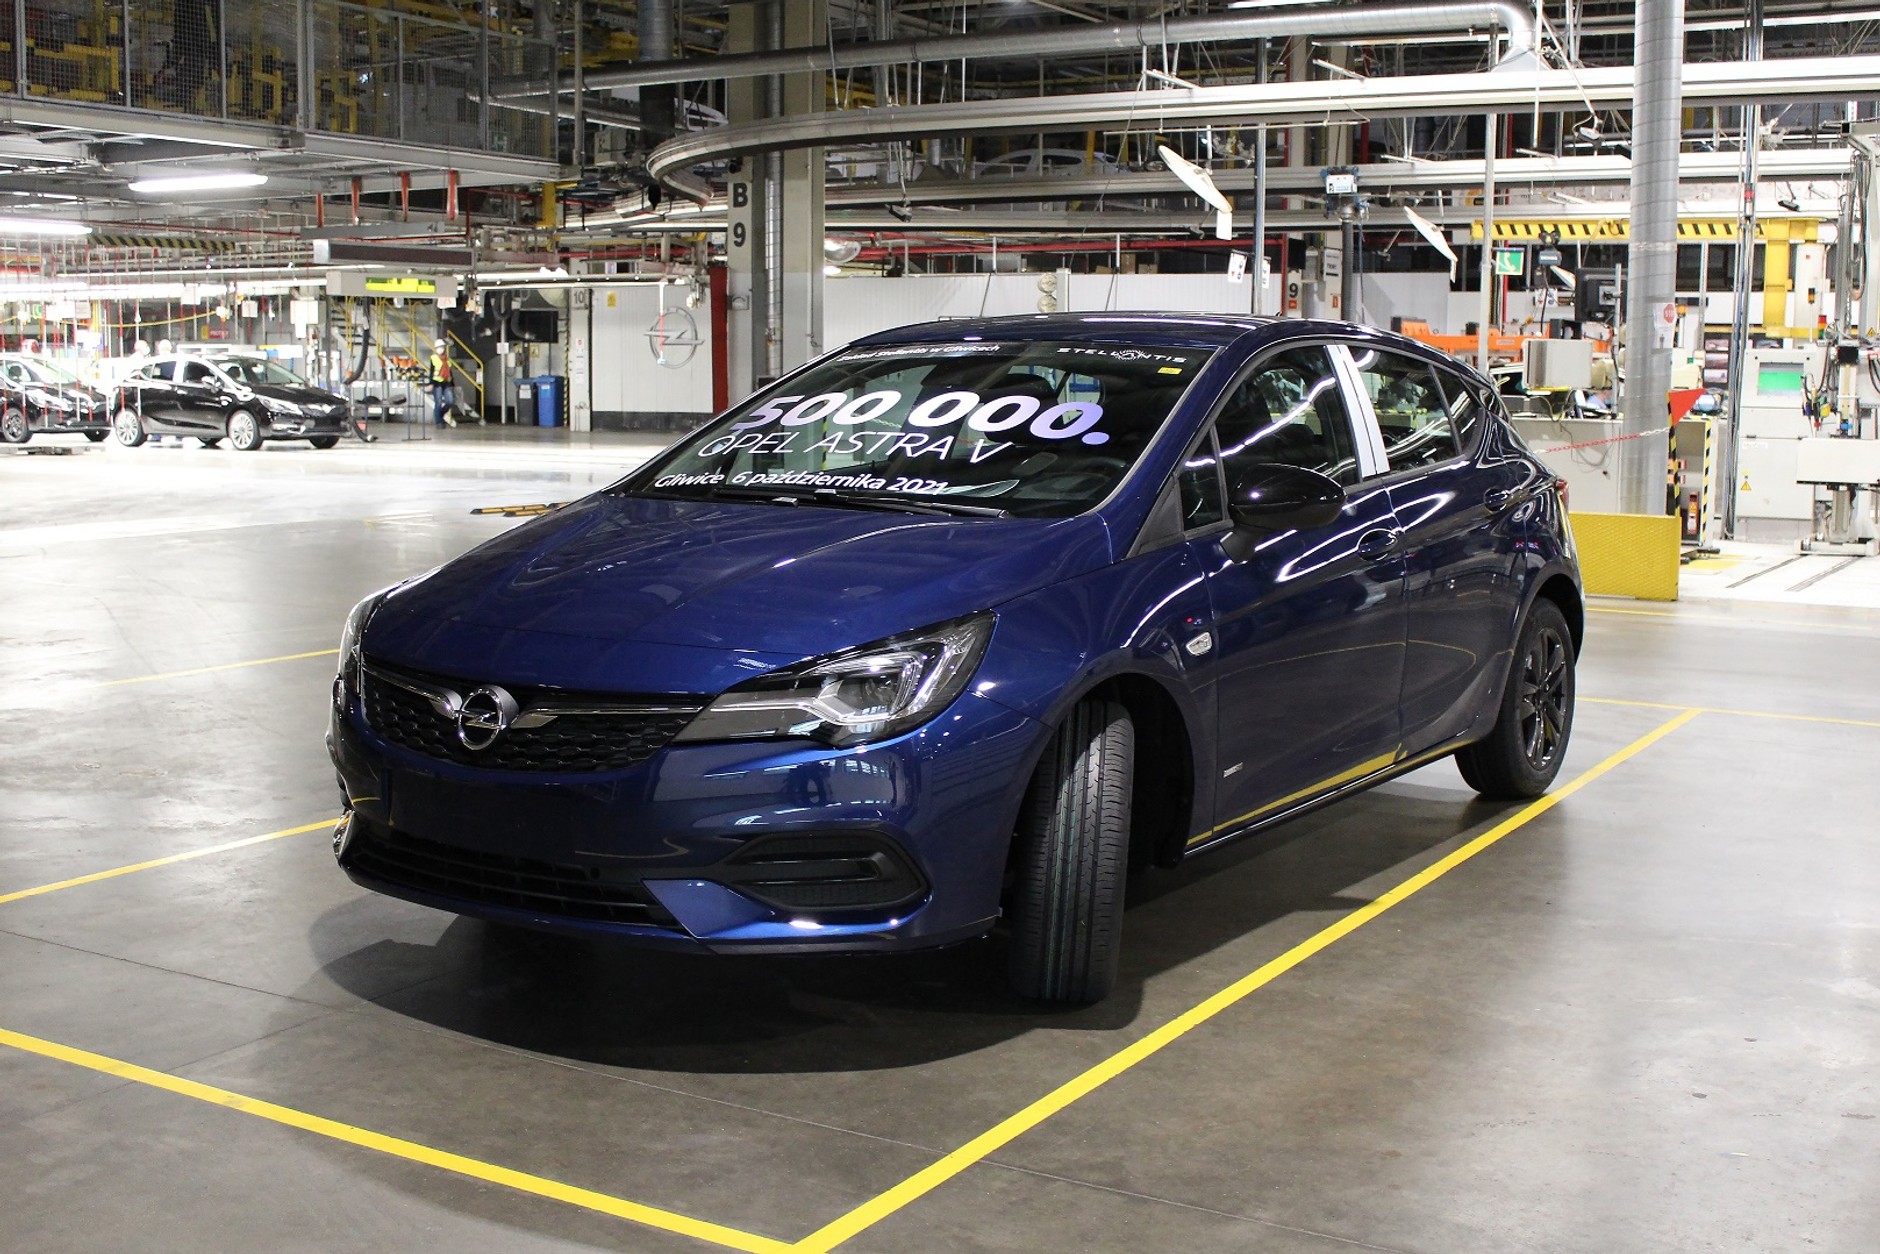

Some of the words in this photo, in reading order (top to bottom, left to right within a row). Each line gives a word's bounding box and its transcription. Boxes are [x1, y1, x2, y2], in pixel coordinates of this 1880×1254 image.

[733, 182, 748, 208] B
[733, 222, 746, 247] 9
[1289, 283, 1298, 298] 9
[1057, 347, 1187, 364] STELLANTIS
[733, 390, 901, 430] 500
[908, 391, 1110, 445] 000.
[697, 431, 800, 458] OPEL
[804, 431, 955, 459] ASTRA
[969, 440, 1015, 464] V
[654, 472, 725, 488] Gliwice
[731, 471, 749, 484] 6
[747, 470, 886, 490] października
[887, 477, 950, 495] 2021
